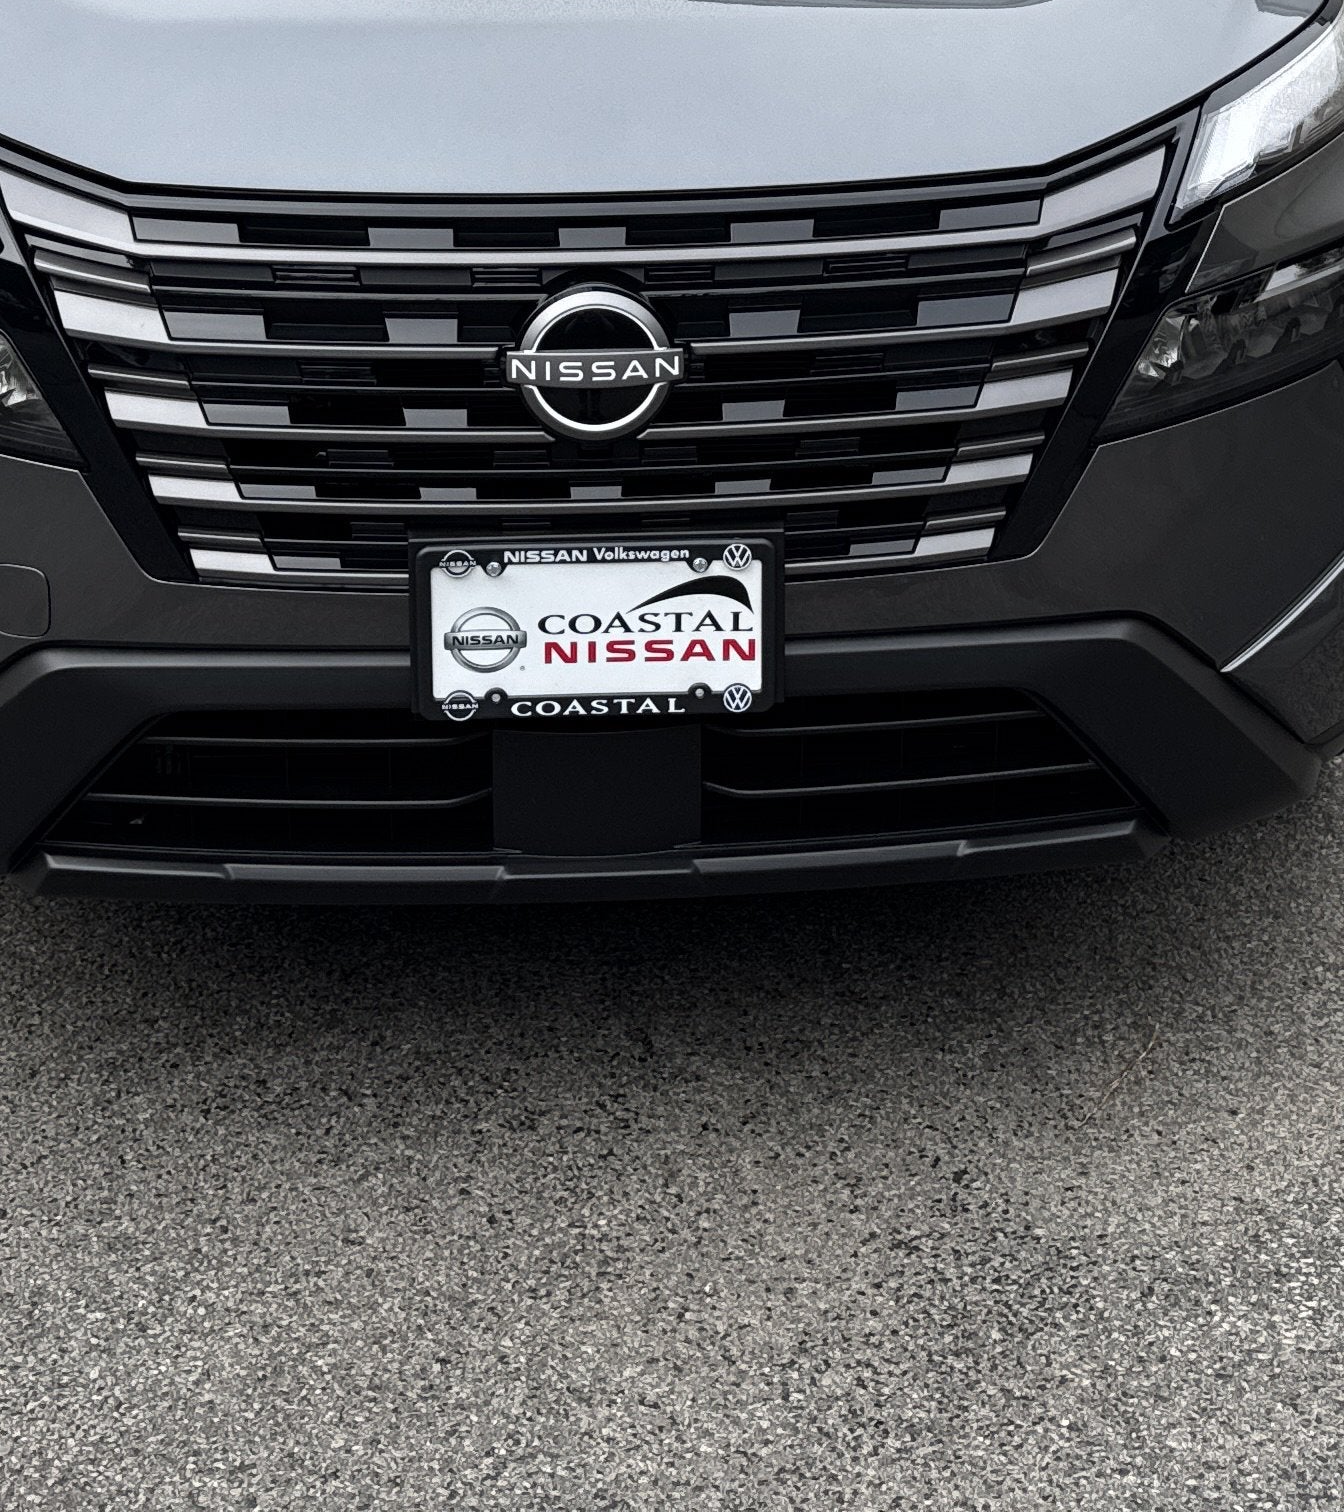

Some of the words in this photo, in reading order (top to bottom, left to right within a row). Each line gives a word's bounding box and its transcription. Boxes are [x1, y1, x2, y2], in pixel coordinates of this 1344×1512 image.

[511, 355, 680, 382] NISSAN
[503, 550, 588, 563] NISSAN
[593, 547, 690, 561] Volkswagen
[538, 610, 753, 635] COASTAL
[452, 635, 519, 646] NISSAN
[544, 639, 756, 664] NISSAN
[511, 697, 686, 717] COASTAL
